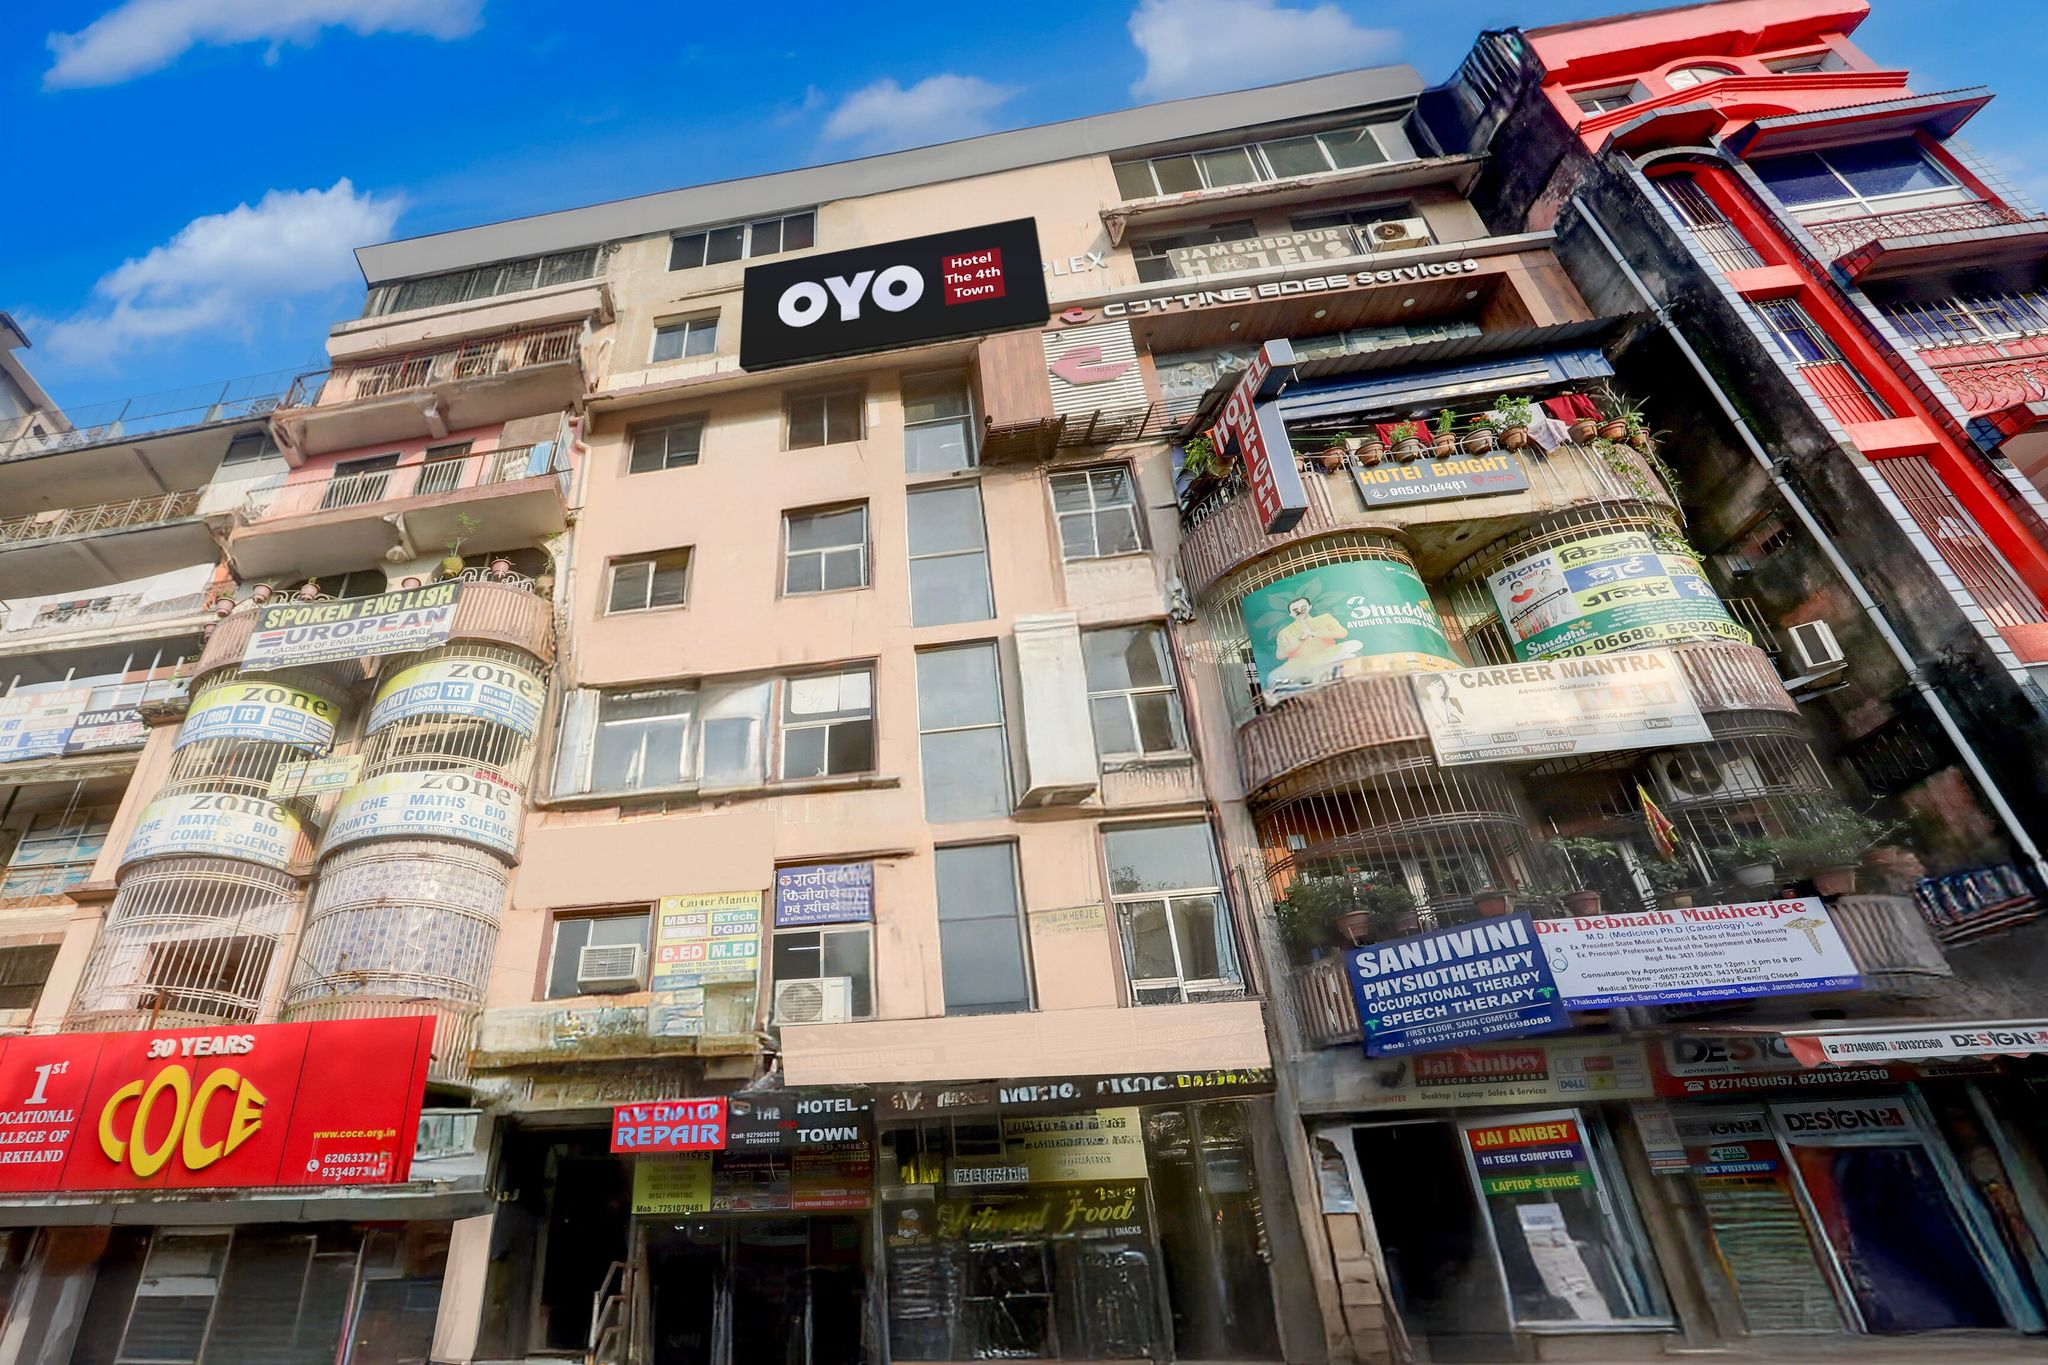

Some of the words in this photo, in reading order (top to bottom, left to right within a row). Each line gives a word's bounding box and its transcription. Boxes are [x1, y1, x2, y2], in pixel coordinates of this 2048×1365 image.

[951, 252, 992, 269] Hotel
[945, 274, 972, 285] The
[975, 267, 1001, 280] 4th
[778, 265, 924, 328] OYO
[954, 284, 995, 298] Town
[1213, 356, 1267, 455] HOTEL
[265, 603, 356, 629] SPOKEN
[264, 642, 311, 656] ACADEMY
[314, 639, 329, 649] OF
[330, 636, 374, 648] ENGLISH
[447, 663, 533, 697] zone
[1460, 665, 1556, 689] CAREER
[1558, 653, 1666, 679] MANTRA
[446, 685, 468, 698] TET
[1518, 686, 1558, 695] Admission
[239, 687, 328, 717] zone
[1444, 752, 1475, 761] Contact
[420, 773, 511, 807] zone
[189, 795, 287, 823] zone
[360, 796, 390, 812] CHE
[409, 794, 467, 809] MATHS
[484, 803, 507, 822] BIO
[139, 820, 162, 835] CHE
[252, 821, 279, 838] BIO
[459, 814, 515, 843] SCIENCE
[223, 831, 288, 858] SCIENCE
[1534, 921, 1567, 935] Dr.
[1574, 911, 1675, 931] Debnath
[1680, 900, 1807, 923] Mukherjee
[1583, 942, 1614, 950] President
[1752, 928, 1788, 937] University
[1586, 933, 1608, 941] M.D.
[1609, 929, 1659, 940] (Medicine)
[1686, 921, 1744, 933] (Cardiology)
[711, 942, 756, 958] M.ED
[1356, 919, 1530, 978] SANJIVINI
[1697, 950, 1726, 958] (Odisha)
[1704, 940, 1745, 949] Department
[1363, 950, 1535, 1000] PHYSIOTHERAPY
[1581, 971, 1631, 979] Consultation
[1643, 966, 1692, 975] Appointment
[1724, 961, 1746, 970] 12pm
[1759, 959, 1771, 967] pm
[1716, 967, 1761, 977] 9431904227
[1369, 985, 1472, 1014] OCCUPATIONAL
[1473, 970, 1540, 992] THERAPY
[1598, 985, 1628, 993] Medical
[1705, 977, 1736, 986] Sunday
[1736, 974, 1770, 982] Evening
[1770, 971, 1799, 979] Closed
[1659, 990, 1696, 1000] Complex,
[1696, 988, 1741, 997] Aambagan,
[1741, 984, 1770, 993] Sakchi,
[1771, 981, 1819, 991] Jamshedpur
[1382, 1005, 1448, 1027] SPEECH
[1451, 988, 1536, 1014] THERAPY
[1383, 1041, 1405, 1051] Mob
[1413, 1029, 1481, 1047] 9931317070,
[1483, 1016, 1551, 1034] 9386698088
[1405, 1028, 1427, 1038] FIRST
[1456, 1019, 1480, 1029] SANA
[1480, 1012, 1520, 1025] COMPLEX
[147, 1038, 177, 1058] 30
[180, 1034, 256, 1057] YEARS
[1891, 1038, 1943, 1051] 6201322560
[1420, 1055, 1454, 1077] Jai
[1460, 1050, 1540, 1074] Ambey
[1436, 1076, 1467, 1085] TECH
[1471, 1073, 1545, 1083] COMPUTERS
[1800, 1069, 1890, 1085] 6201322560
[1421, 1091, 1451, 1101] Desktop
[1458, 1090, 1484, 1100] Laptop
[1488, 1088, 1508, 1096] Sales
[1517, 1086, 1547, 1096] Services
[796, 1098, 859, 1115] HOTEL
[98, 1064, 268, 1177] COCE
[48, 1130, 71, 1143] OF
[313, 1127, 397, 1140] www.coce.org.in
[616, 1124, 720, 1148] REPAIR
[796, 1126, 859, 1143] TOWN
[1476, 1130, 1505, 1146] JAI
[1509, 1124, 1569, 1143] AMBEY
[1482, 1156, 1493, 1165] HI
[1494, 1154, 1519, 1164] TECH
[1521, 1150, 1574, 1162] COMPUTER
[1491, 1179, 1532, 1192] LAPTOP
[1535, 1175, 1582, 1188] SERVICE
[636, 1204, 652, 1213] Mob
[1115, 1225, 1142, 1236] SNACKS
